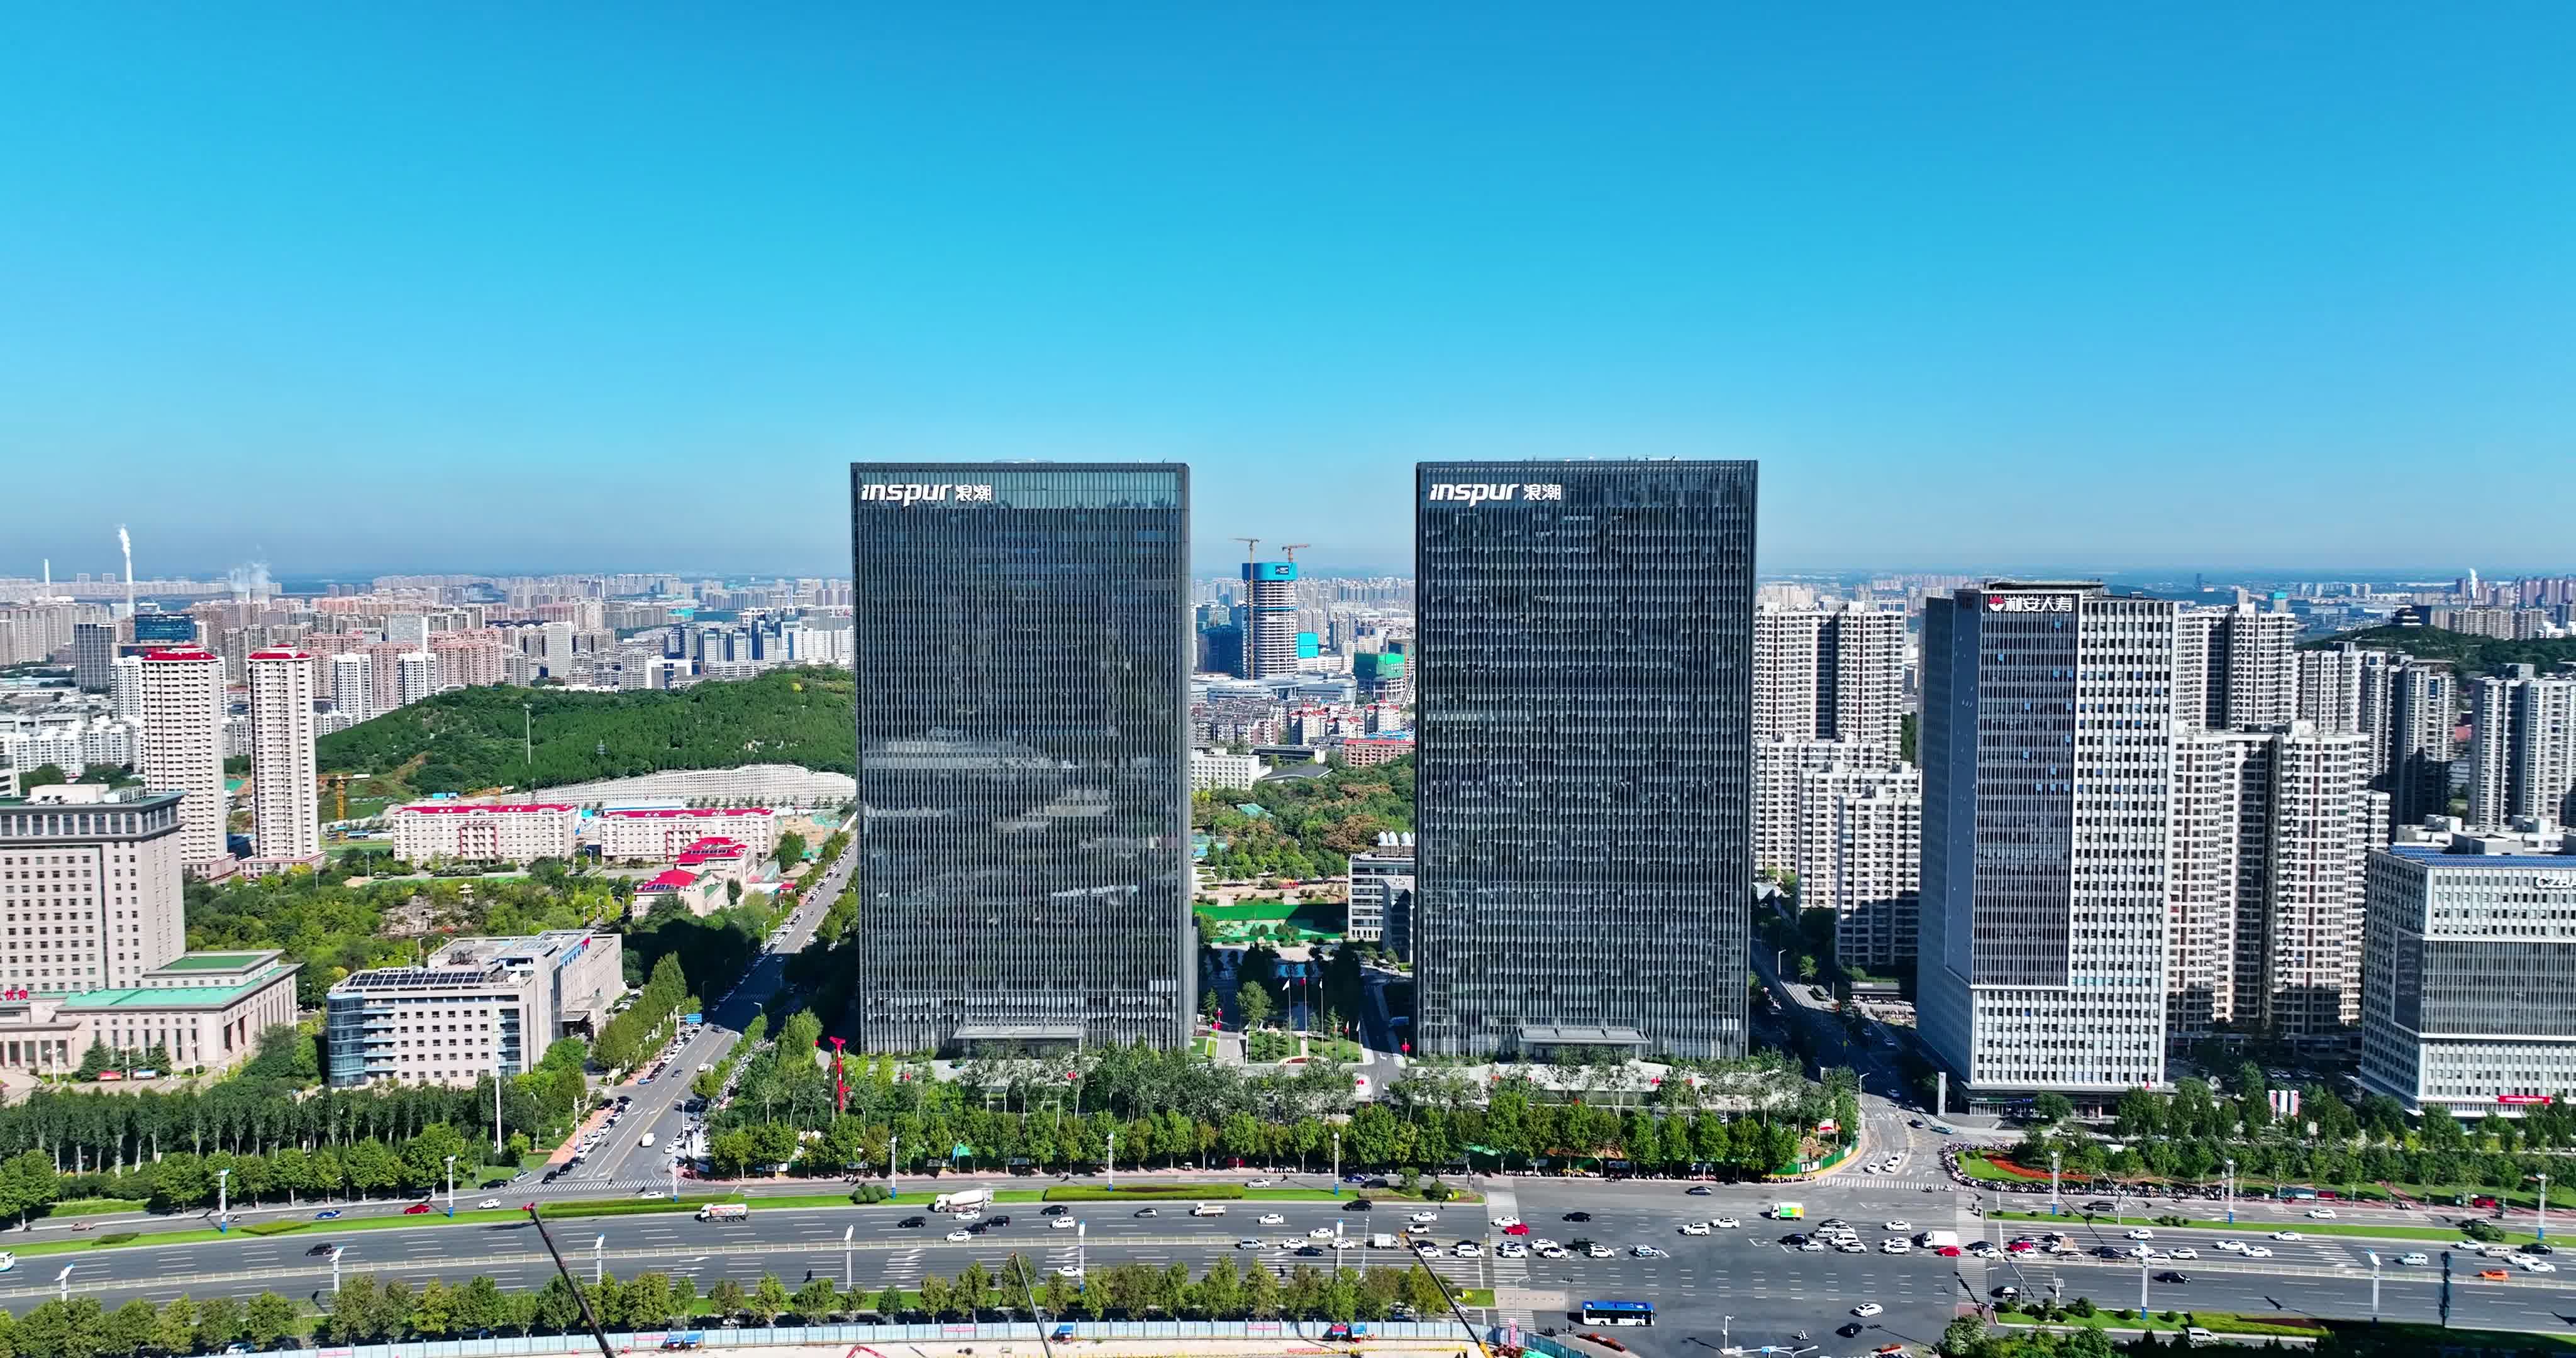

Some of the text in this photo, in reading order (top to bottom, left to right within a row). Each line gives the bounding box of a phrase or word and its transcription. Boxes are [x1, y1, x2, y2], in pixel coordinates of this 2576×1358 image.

[861, 483, 992, 507] inspur 浪潮
[1430, 483, 1562, 507] inspur 浪潮
[2004, 596, 2073, 612] 利安人寿
[0, 989, 28, 1001] 优良
